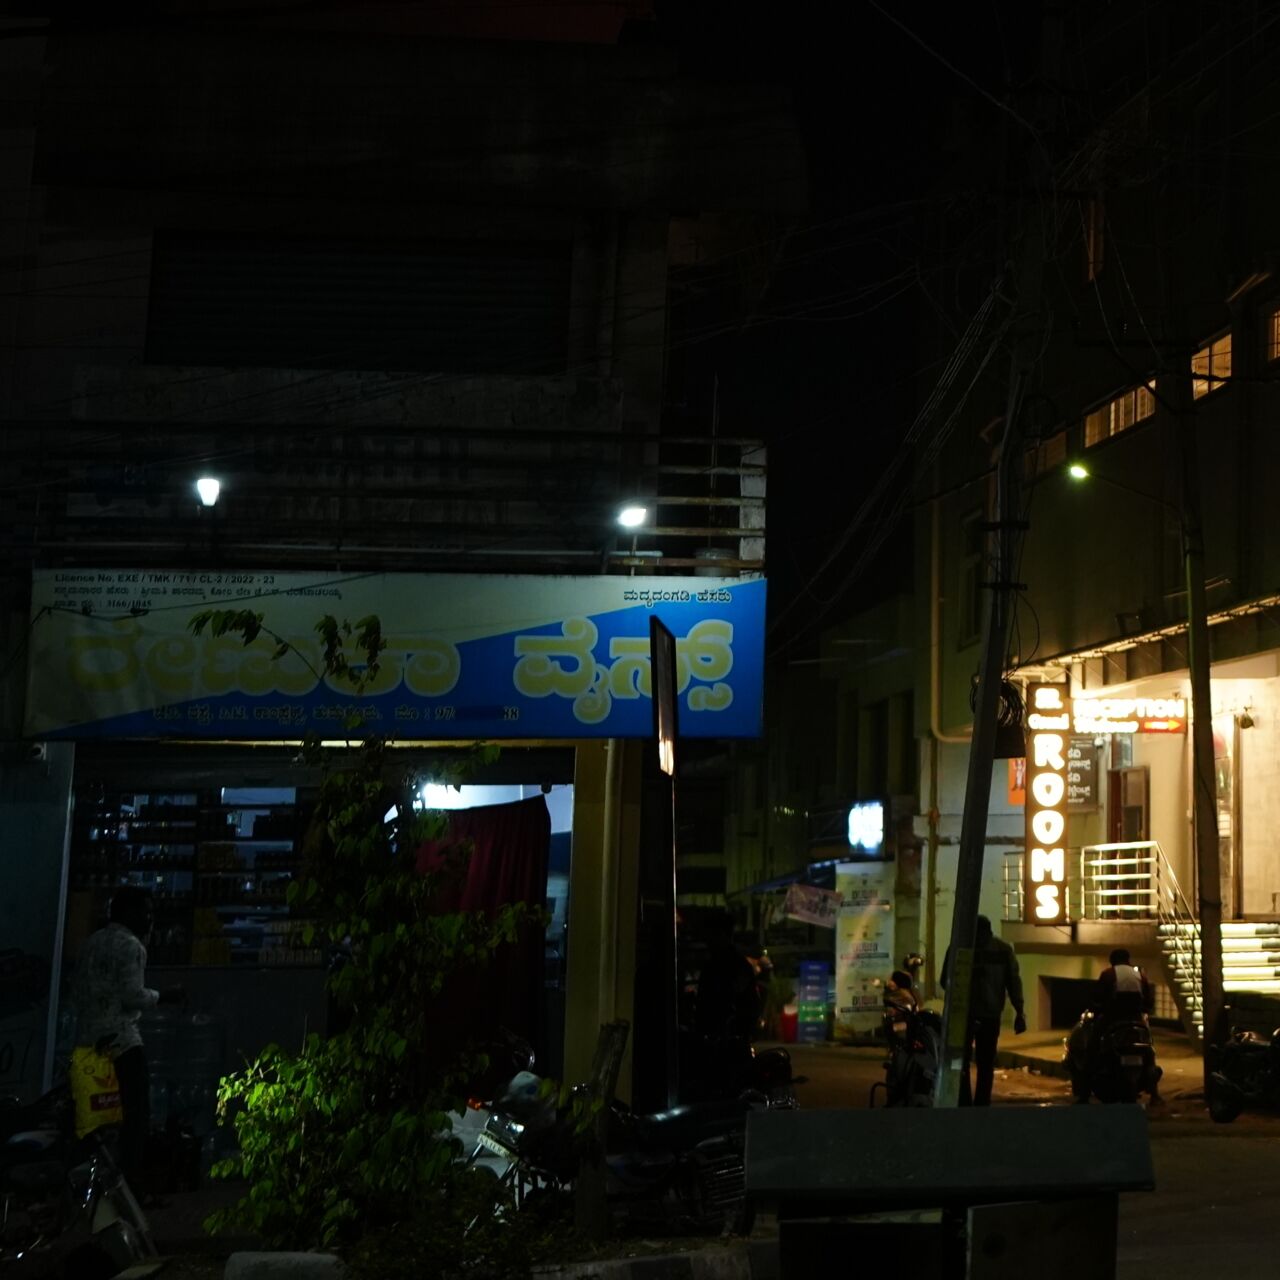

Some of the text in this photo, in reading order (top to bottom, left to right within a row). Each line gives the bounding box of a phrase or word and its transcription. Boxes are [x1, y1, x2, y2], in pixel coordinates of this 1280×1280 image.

[117, 574, 139, 583] EXE
[148, 575, 171, 583] TMK
[199, 575, 223, 584] CL-2
[230, 575, 254, 584] 2022
[1073, 698, 1185, 718] RECEPTION
[1031, 733, 1065, 919] ROOMS
